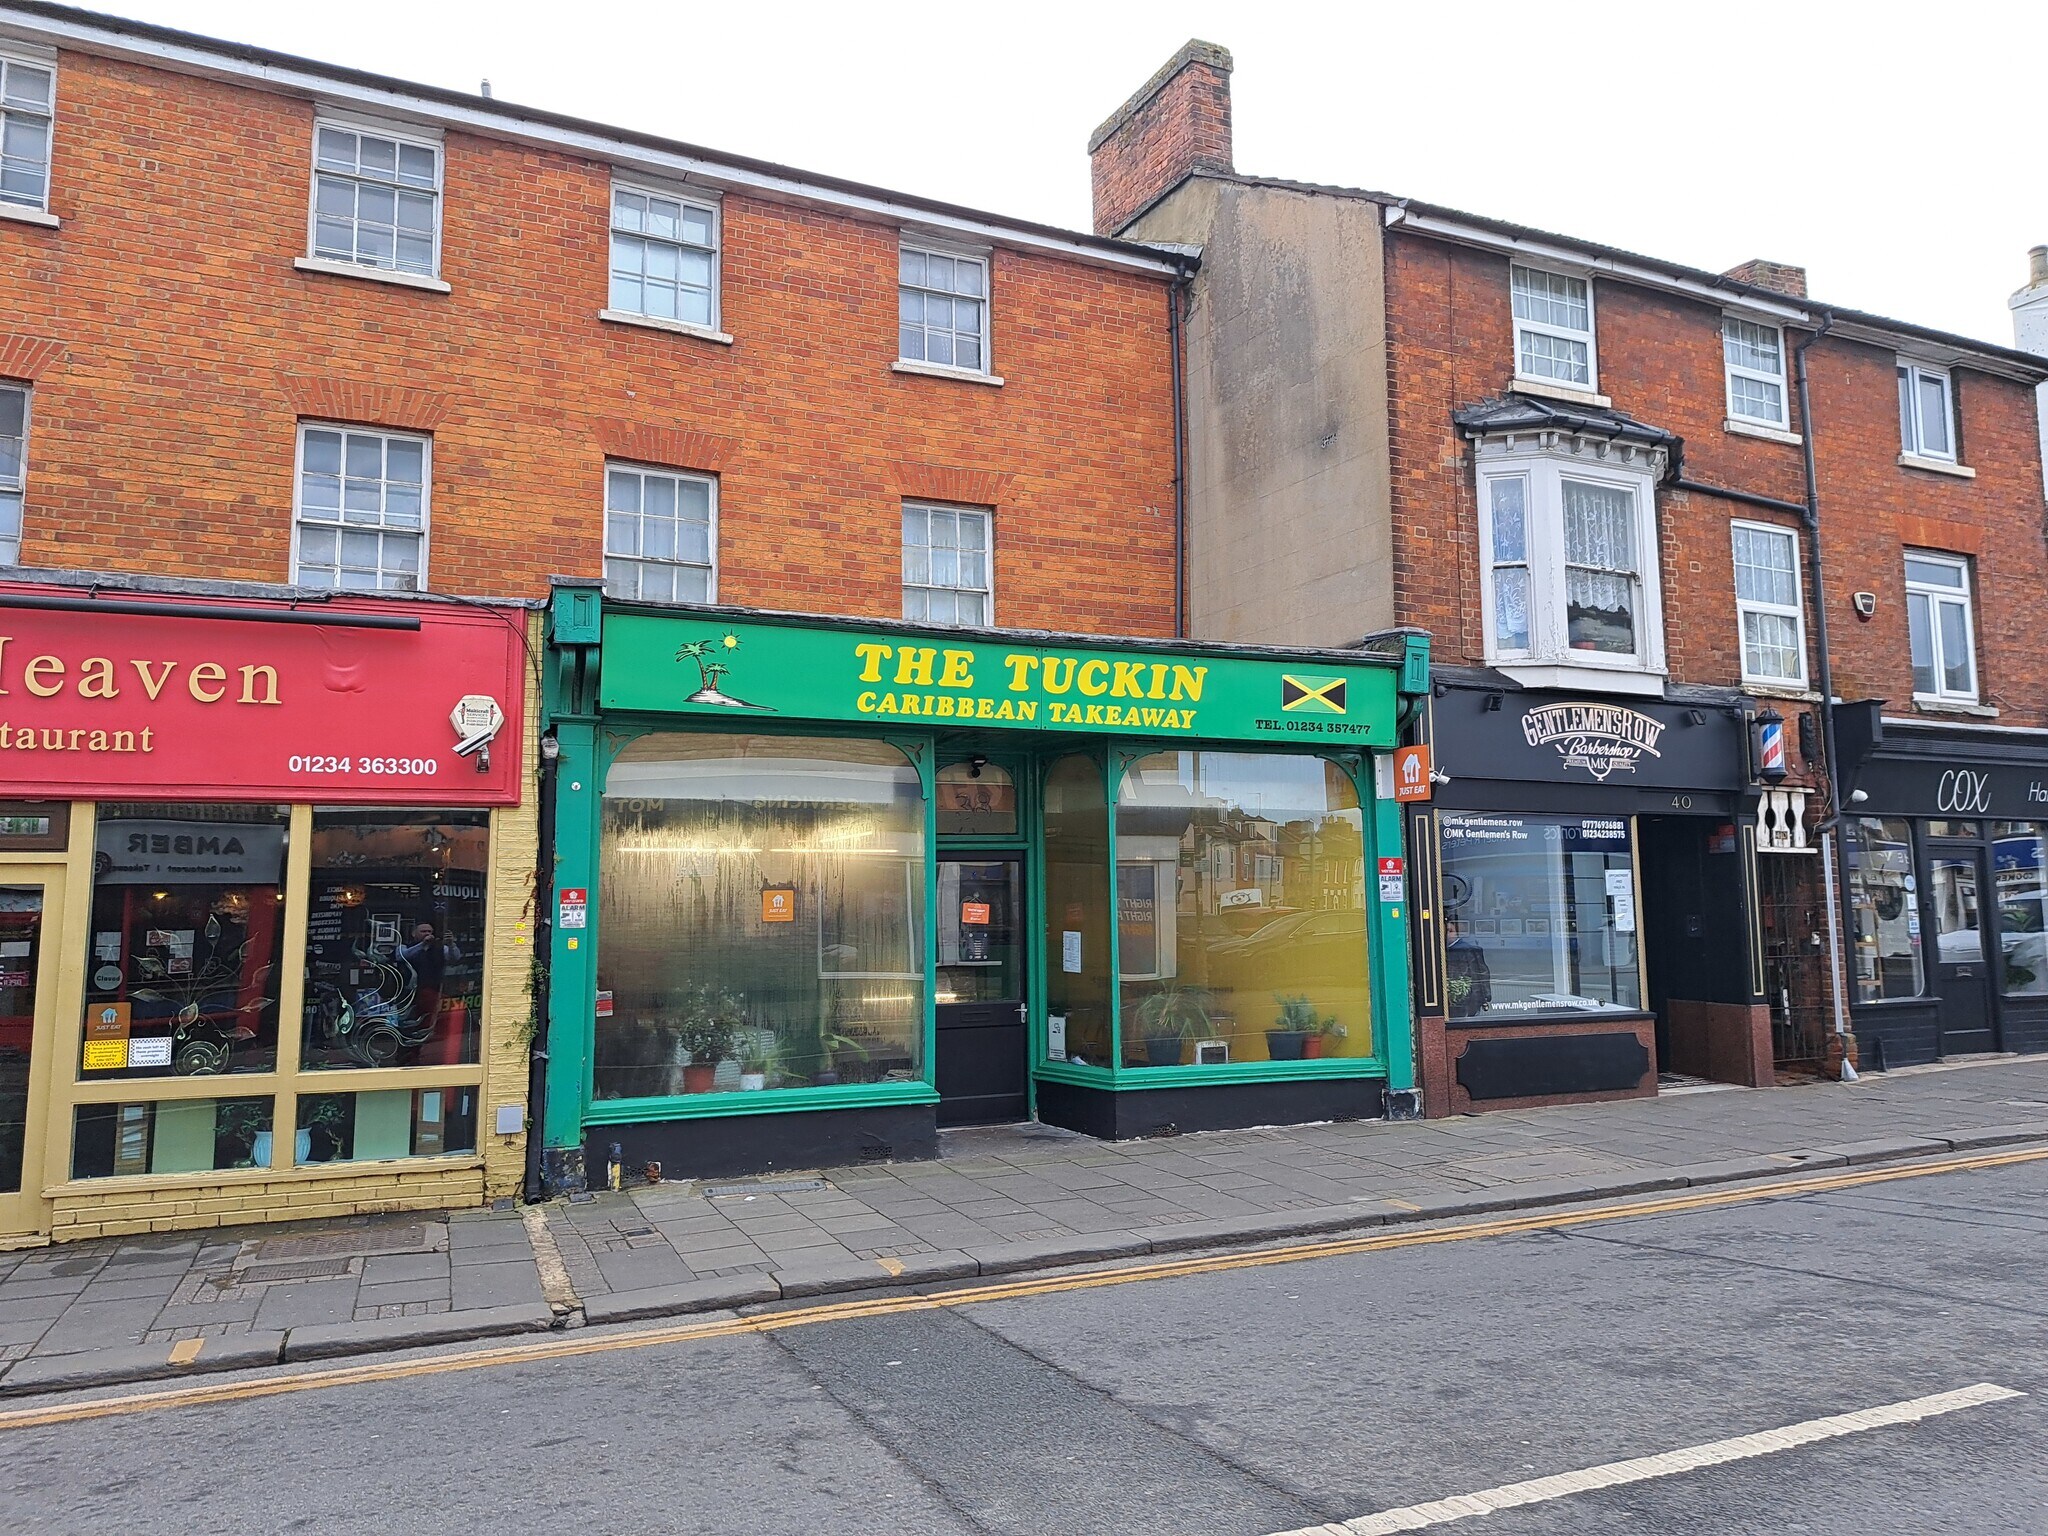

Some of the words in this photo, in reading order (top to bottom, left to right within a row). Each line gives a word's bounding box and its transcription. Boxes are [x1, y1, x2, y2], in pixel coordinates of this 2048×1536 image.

[855, 643, 975, 688] THE
[1004, 654, 1208, 702] TUCKIN
[856, 692, 1039, 721] CARIBBEAN
[1048, 702, 1197, 729] TAKEAWAY
[1255, 719, 1285, 731] TEL.
[1286, 721, 1323, 732] 01234
[1326, 723, 1371, 735] 357477
[1564, 735, 1634, 758] Barbershop
[288, 756, 351, 773] 01234
[358, 757, 437, 775] 363300
[1591, 757, 1609, 769] MK
[1398, 787, 1413, 796] JUST
[1414, 785, 1426, 794] EAT
[1937, 770, 1992, 813] COX
[2027, 781, 2048, 802] Ha
[1671, 795, 1692, 809] 40
[1452, 829, 1464, 838] MK
[1466, 829, 1510, 839] Gentlemen's
[1512, 831, 1528, 839] Row
